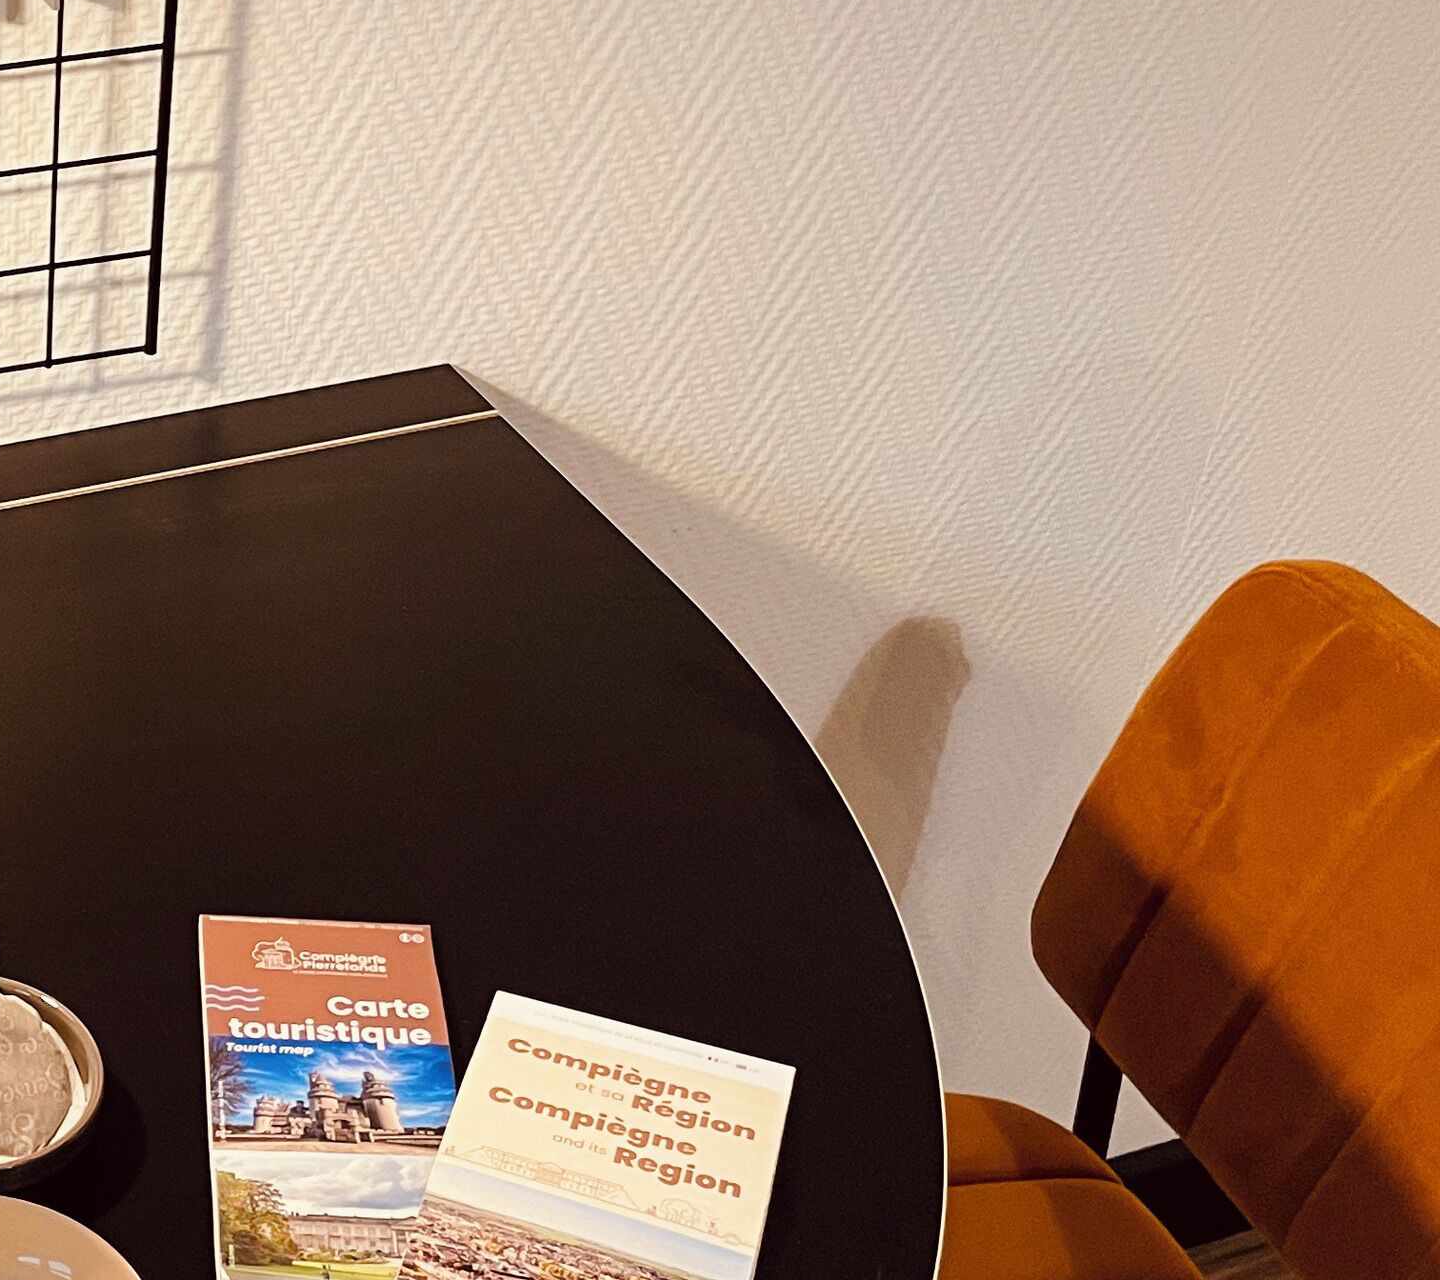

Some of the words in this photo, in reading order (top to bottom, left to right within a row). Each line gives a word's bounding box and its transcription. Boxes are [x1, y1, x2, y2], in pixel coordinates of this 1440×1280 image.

[227, 1017, 433, 1051] touristique
[326, 996, 431, 1020] Carte
[225, 1041, 278, 1054] Tourist
[278, 1045, 314, 1057] map
[507, 1037, 712, 1104] Compiègne
[488, 1086, 698, 1156] Compiègne
[574, 1080, 594, 1095] et
[599, 1088, 625, 1102] sa
[631, 1094, 757, 1141] Région
[551, 1132, 585, 1150] and
[586, 1140, 608, 1156] its
[613, 1146, 743, 1199] Region
